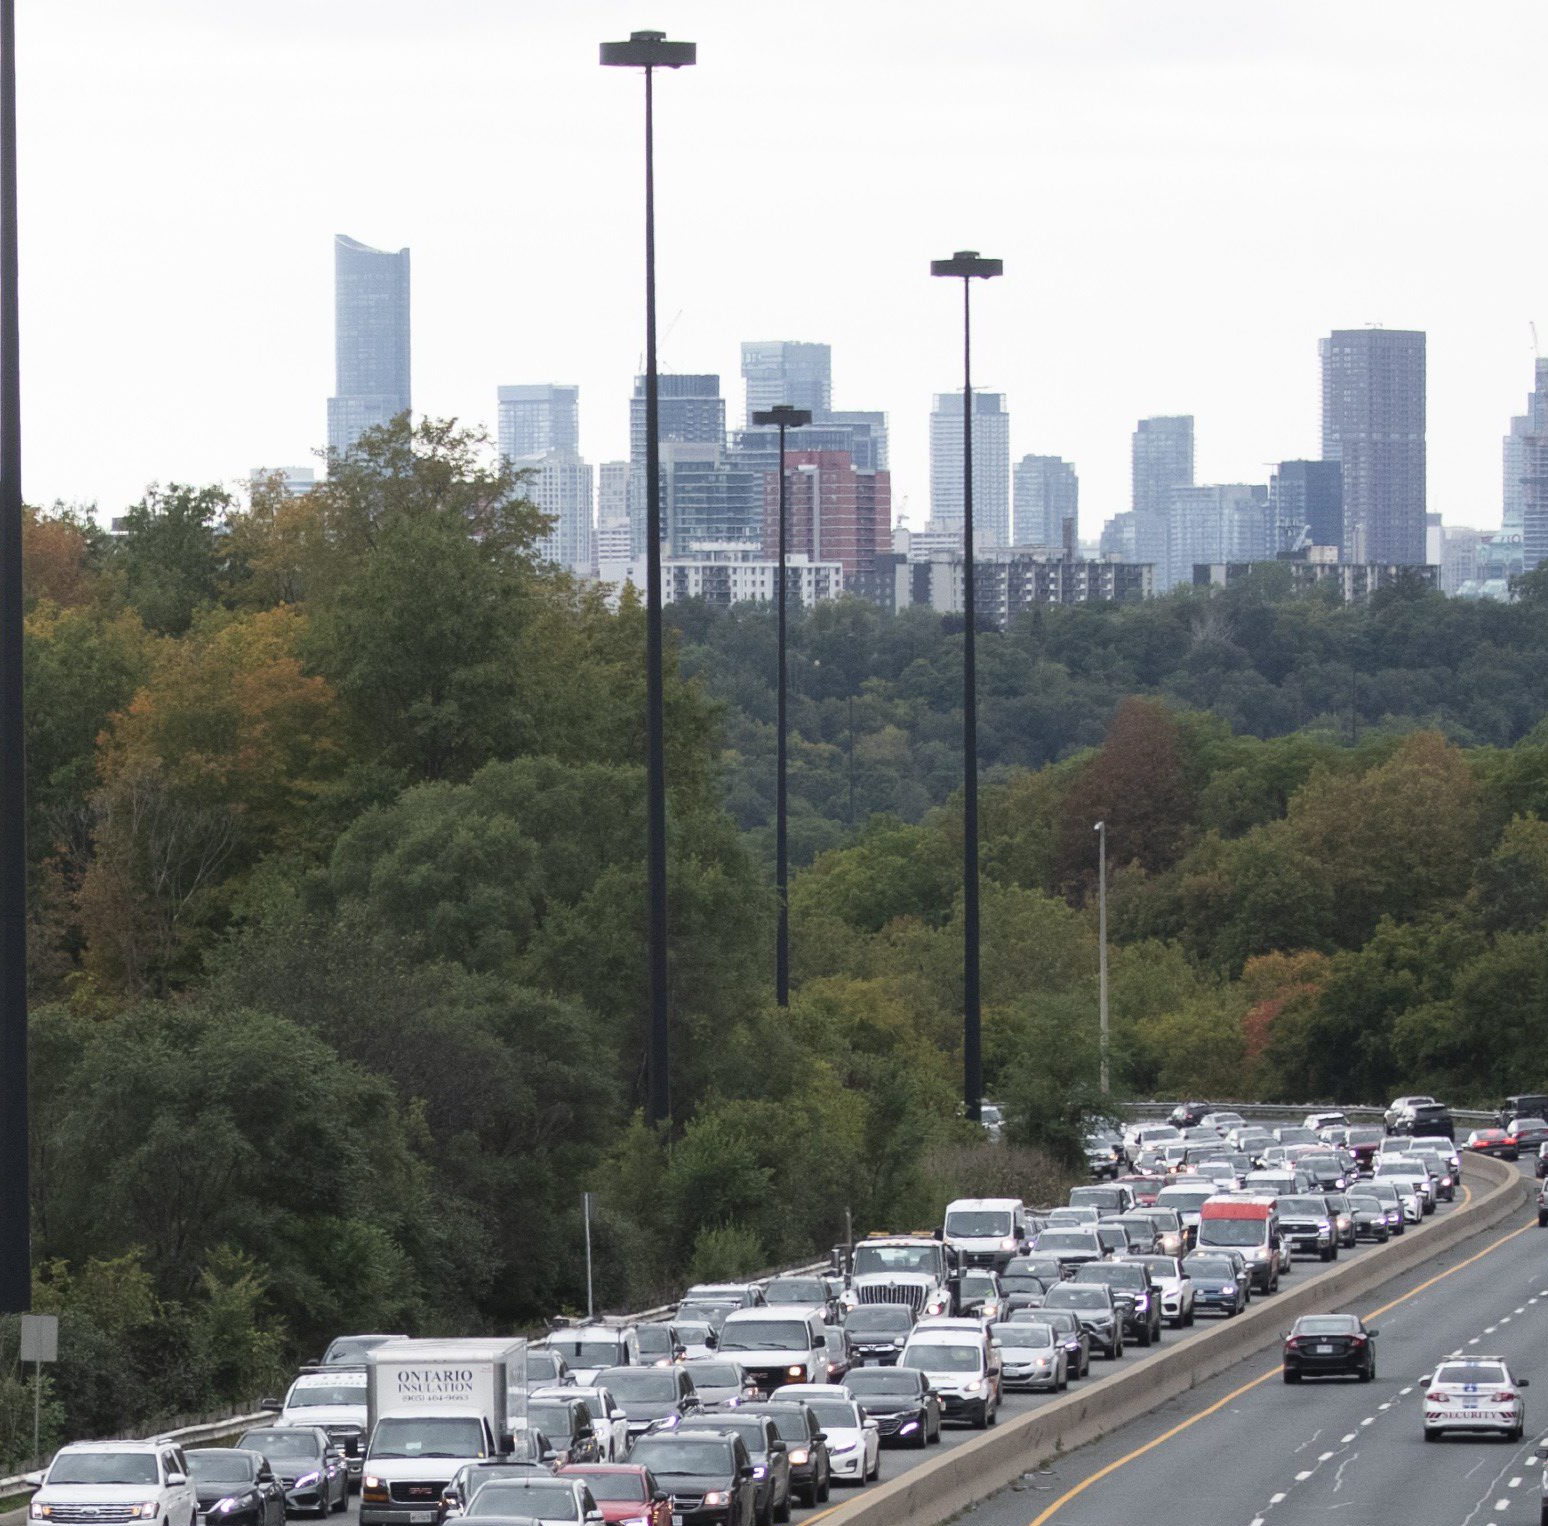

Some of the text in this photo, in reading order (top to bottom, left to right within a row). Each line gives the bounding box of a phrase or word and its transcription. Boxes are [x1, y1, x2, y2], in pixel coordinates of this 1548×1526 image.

[398, 1370, 473, 1383] ONTARIO
[398, 1382, 473, 1393] INSULATION
[1442, 1411, 1497, 1420] SECURITY
